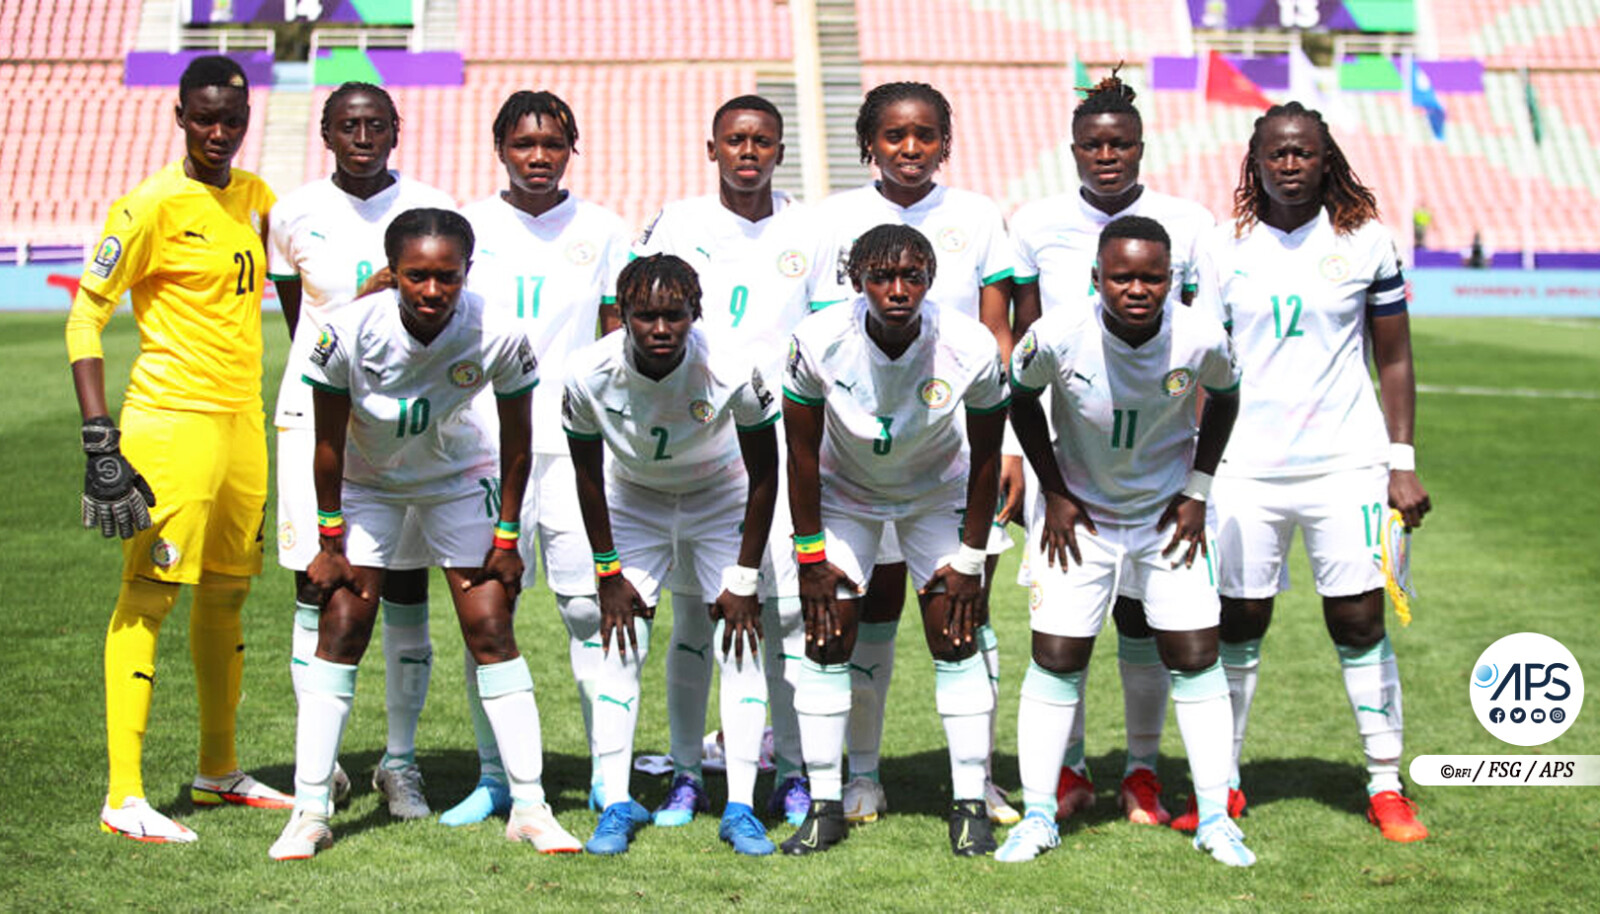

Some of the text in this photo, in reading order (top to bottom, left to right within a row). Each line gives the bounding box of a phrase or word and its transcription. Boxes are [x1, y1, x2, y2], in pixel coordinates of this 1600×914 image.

[234, 250, 254, 296] 21
[515, 275, 546, 319] 17
[729, 284, 749, 328] 9
[1270, 294, 1304, 339] 12
[397, 397, 430, 437] 10
[873, 416, 893, 455] 3
[1112, 409, 1137, 449] 11
[651, 426, 672, 461] 2
